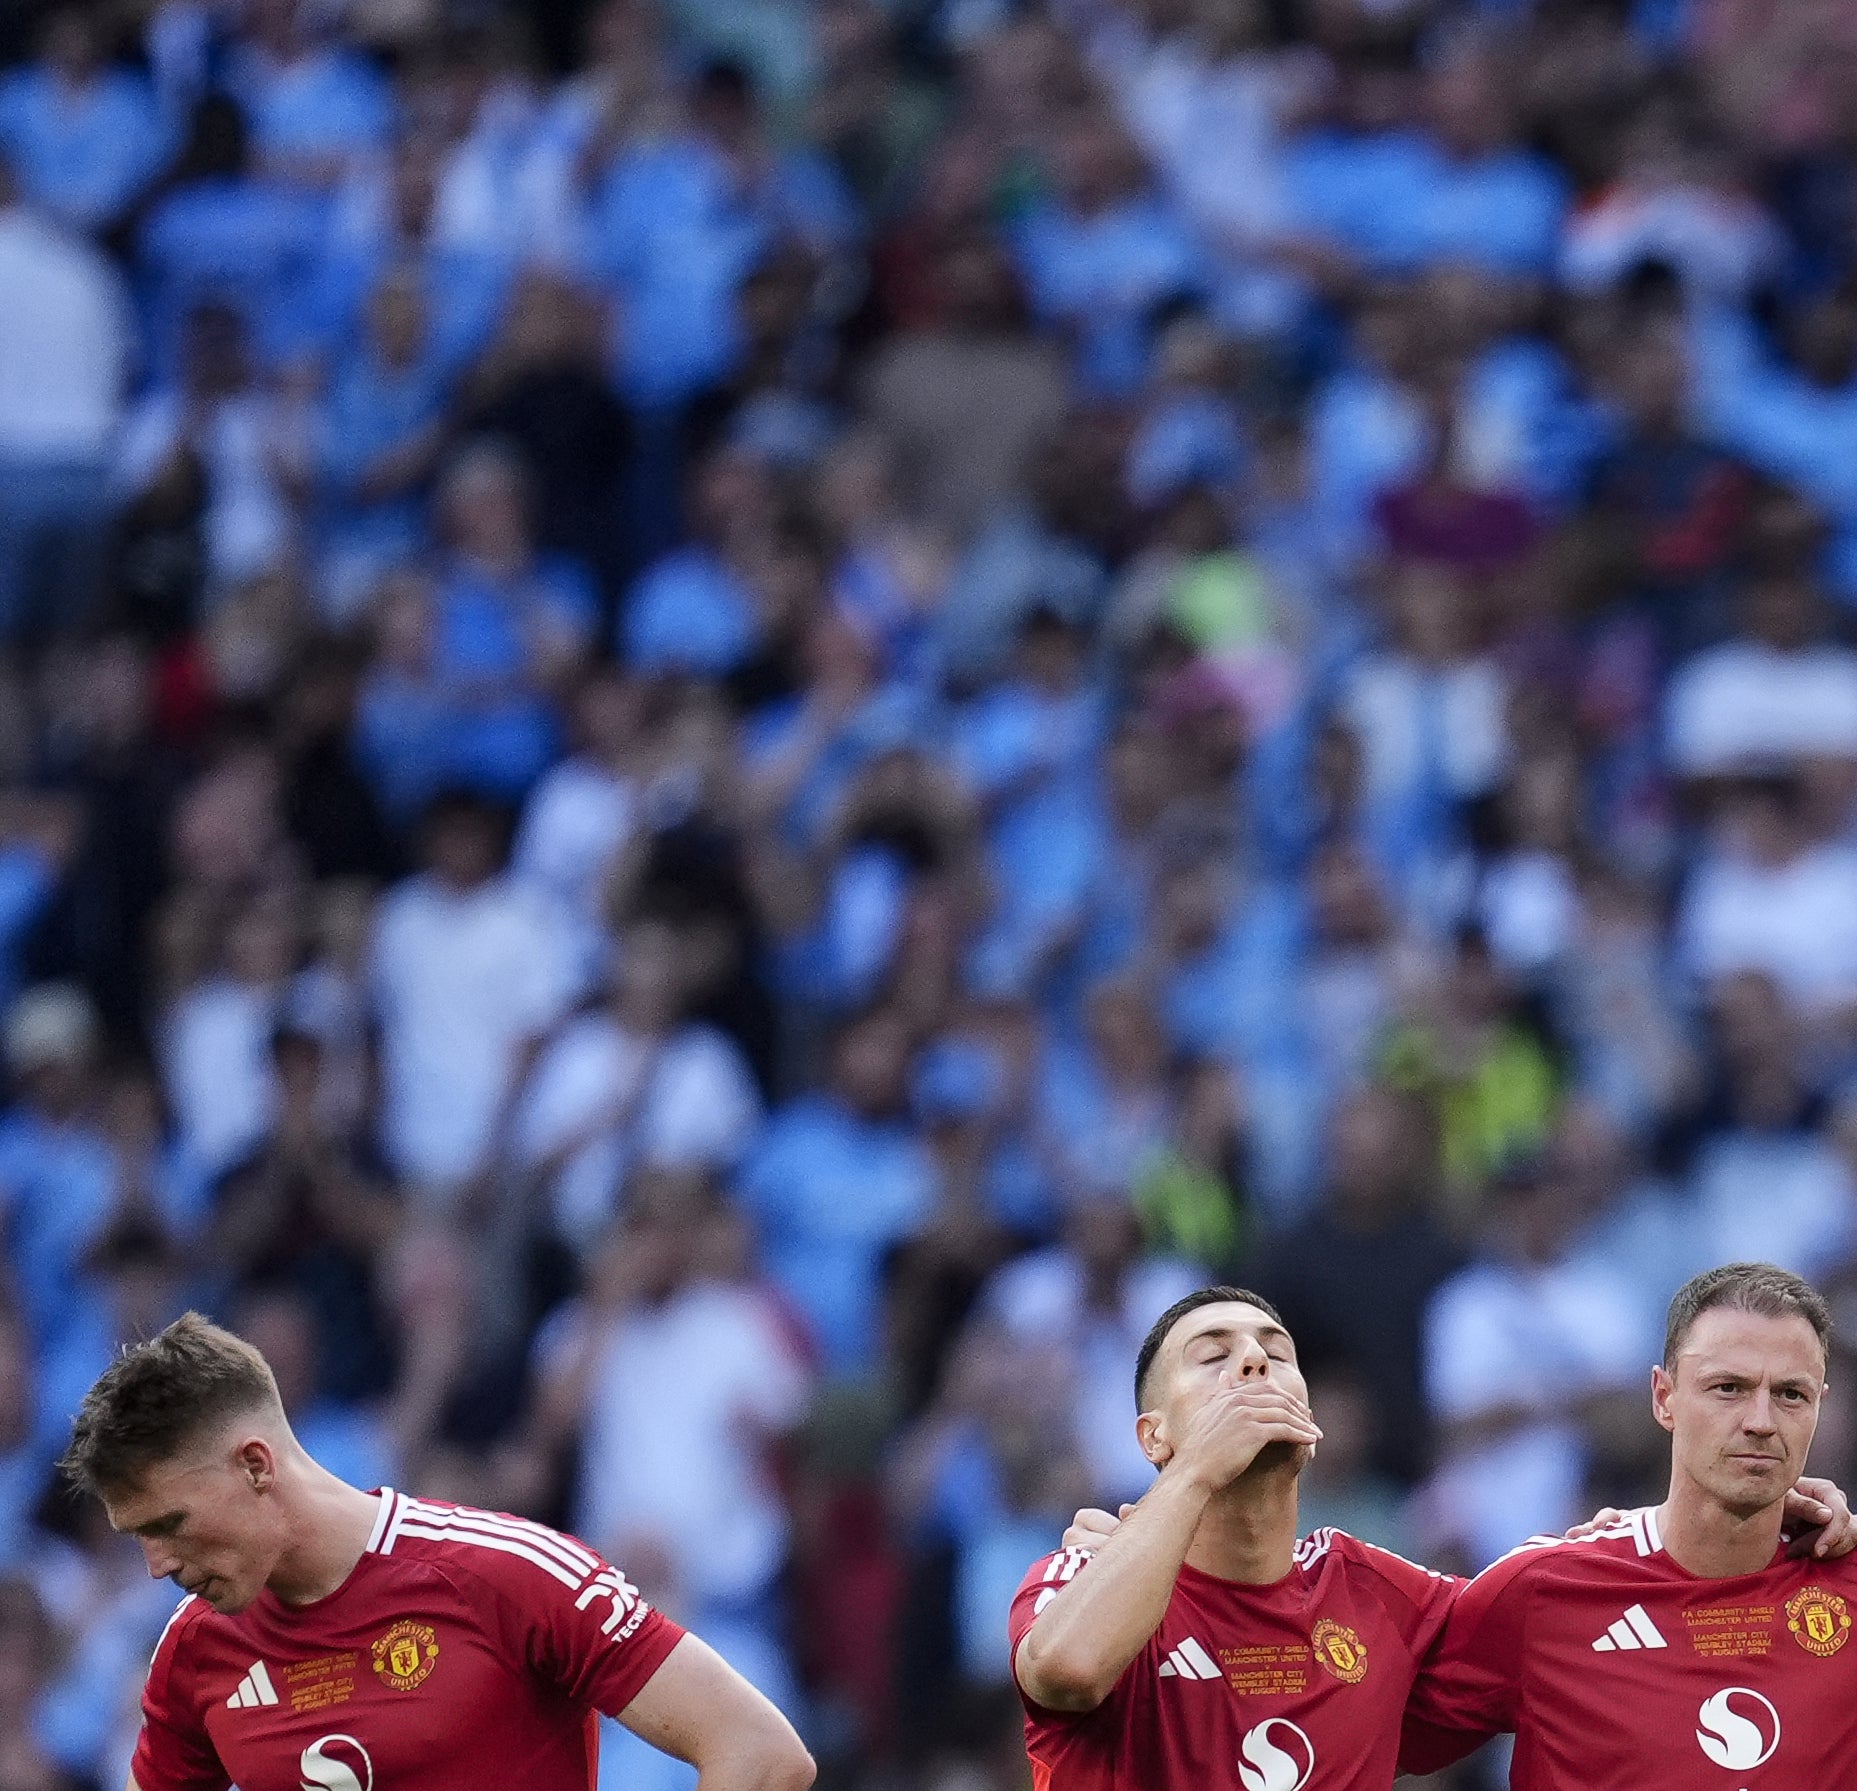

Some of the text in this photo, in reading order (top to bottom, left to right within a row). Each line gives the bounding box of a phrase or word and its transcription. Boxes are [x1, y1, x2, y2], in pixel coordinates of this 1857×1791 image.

[1790, 1590, 1842, 1615] MANCHESTER
[1807, 1637, 1841, 1651] UNITED
[390, 1668, 427, 1687] UNITED
